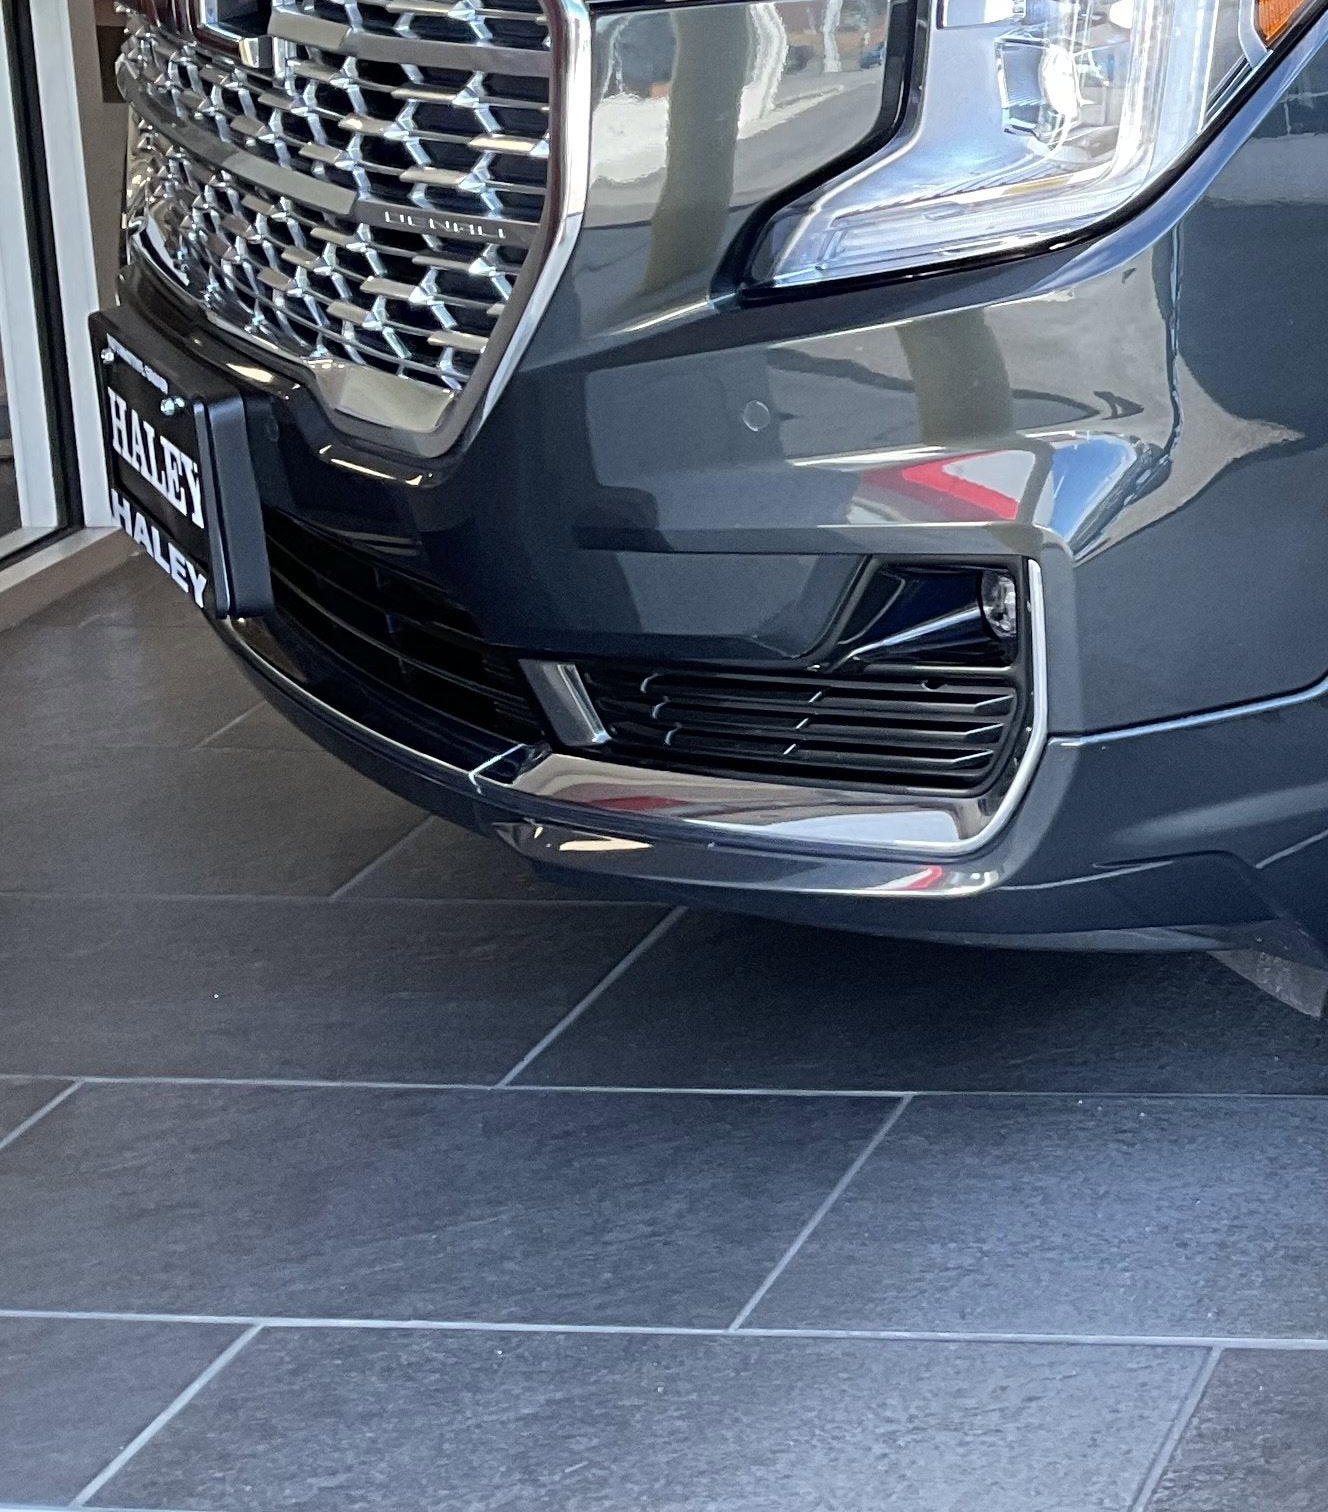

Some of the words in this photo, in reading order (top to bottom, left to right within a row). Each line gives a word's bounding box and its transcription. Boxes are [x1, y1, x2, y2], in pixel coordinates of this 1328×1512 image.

[384, 210, 506, 240] DENALI
[107, 386, 205, 529] HALEY
[111, 488, 207, 609] HALEY
